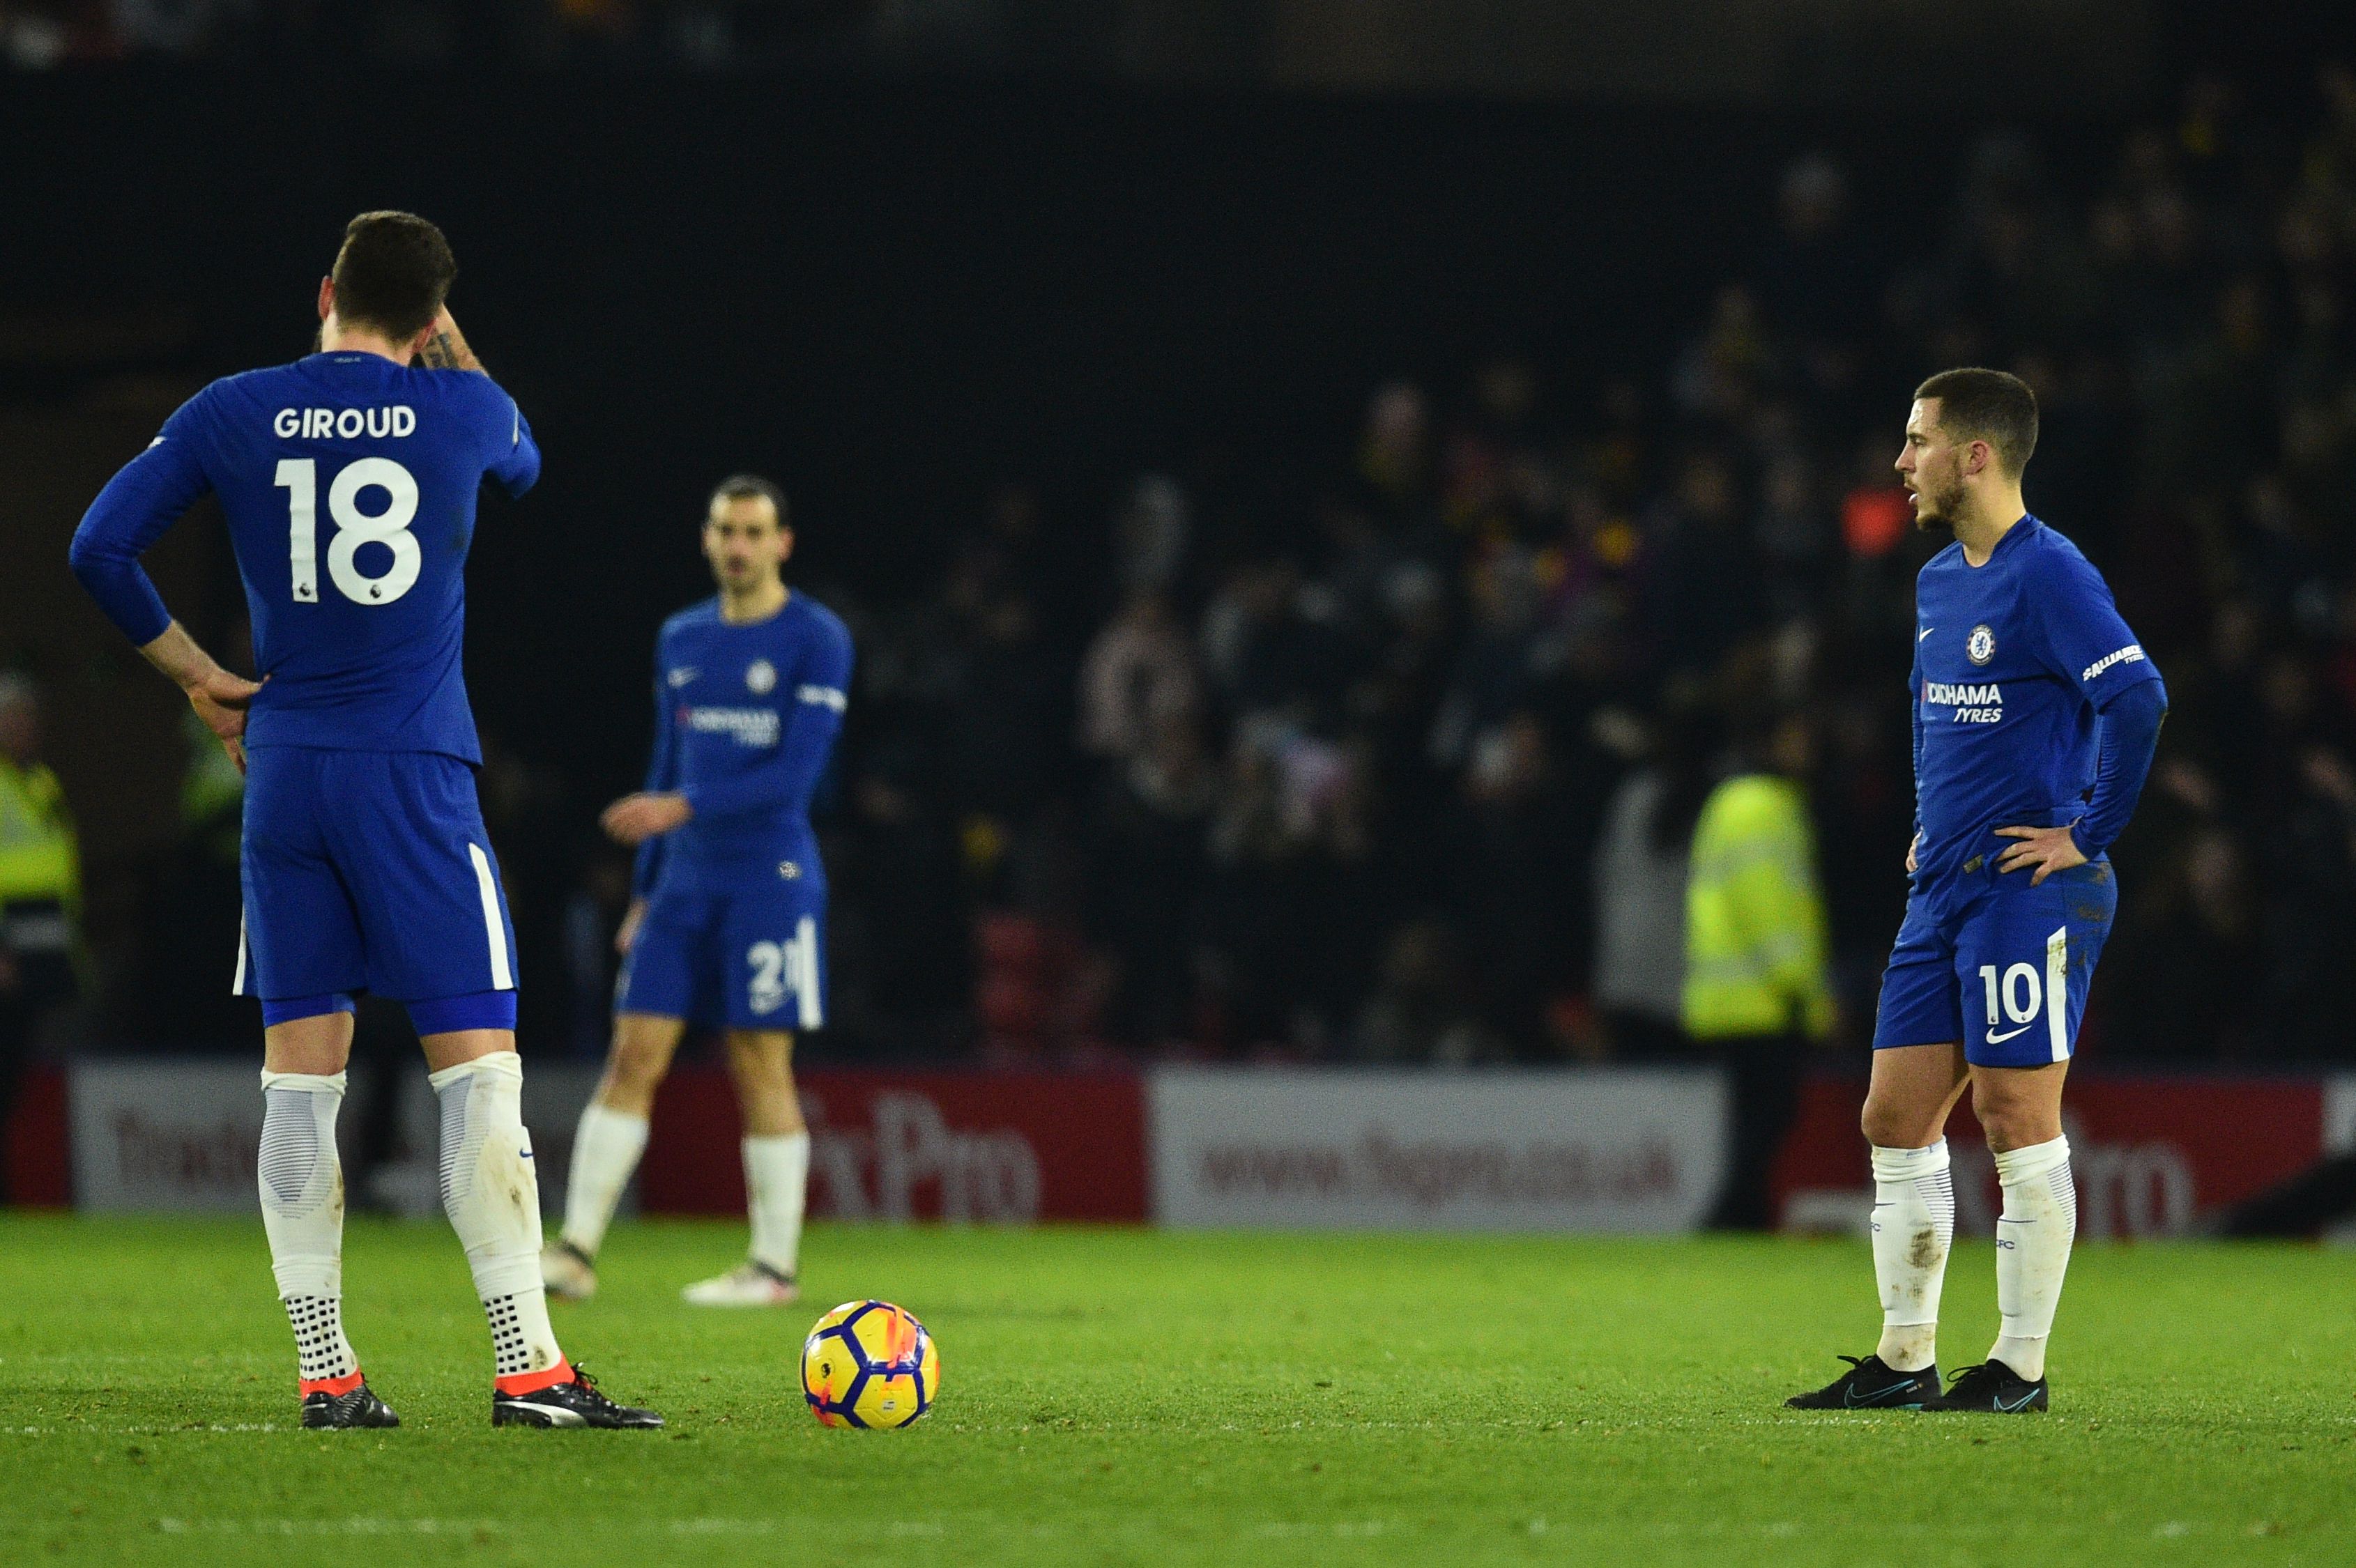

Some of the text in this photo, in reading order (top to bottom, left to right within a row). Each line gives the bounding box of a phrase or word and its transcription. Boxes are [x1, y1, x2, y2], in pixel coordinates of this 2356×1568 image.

[274, 405, 416, 438] GIROUD
[274, 456, 422, 606] 18
[1953, 708, 2003, 723] TYRES
[1978, 962, 2042, 1024] 10
